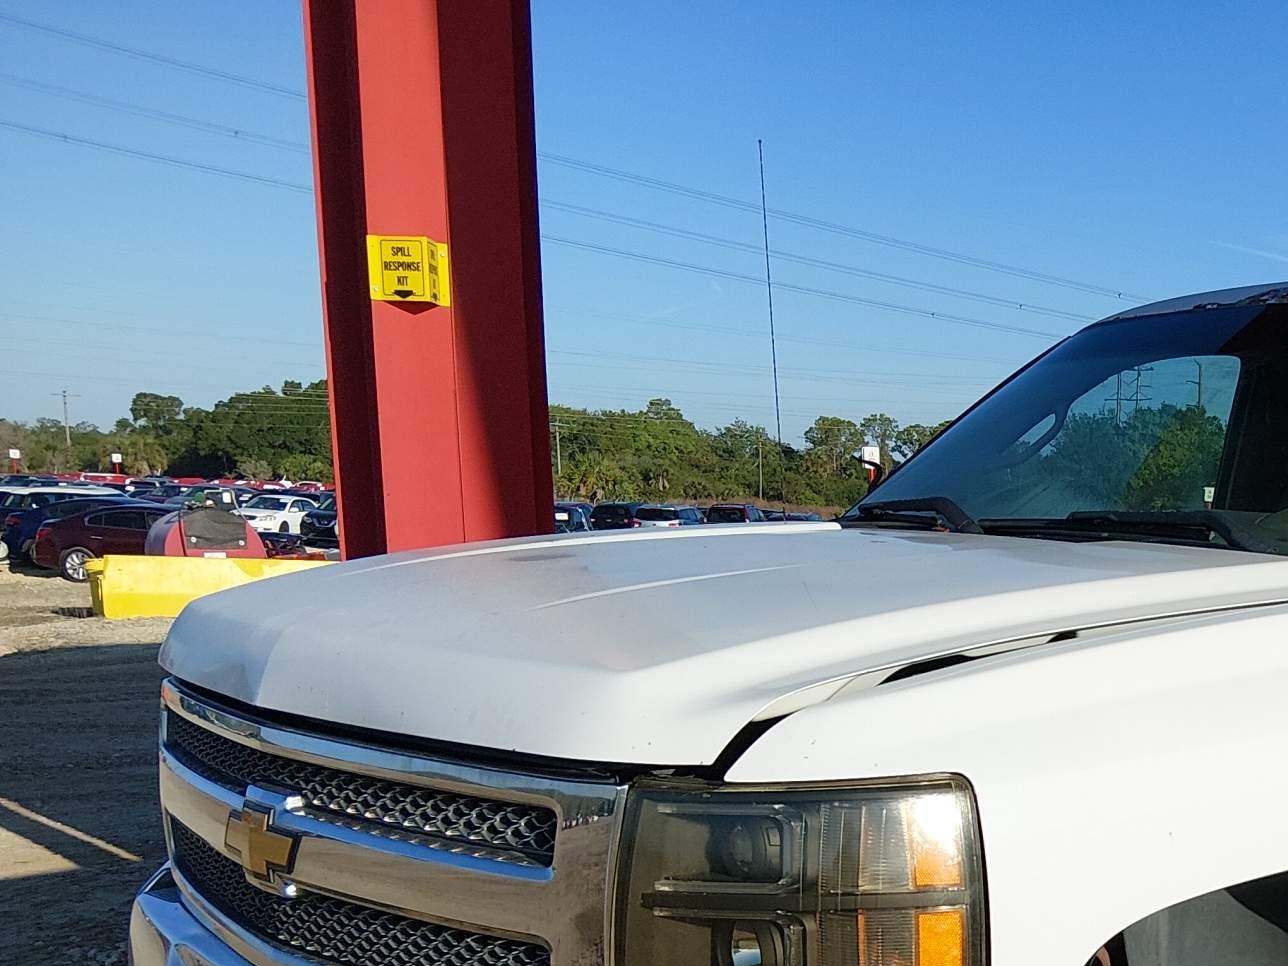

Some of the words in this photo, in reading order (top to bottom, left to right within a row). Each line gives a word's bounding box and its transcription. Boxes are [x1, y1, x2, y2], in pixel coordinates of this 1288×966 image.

[391, 246, 411, 257] SPILL
[384, 261, 421, 272] RESPONSE
[397, 276, 408, 286] KIT
